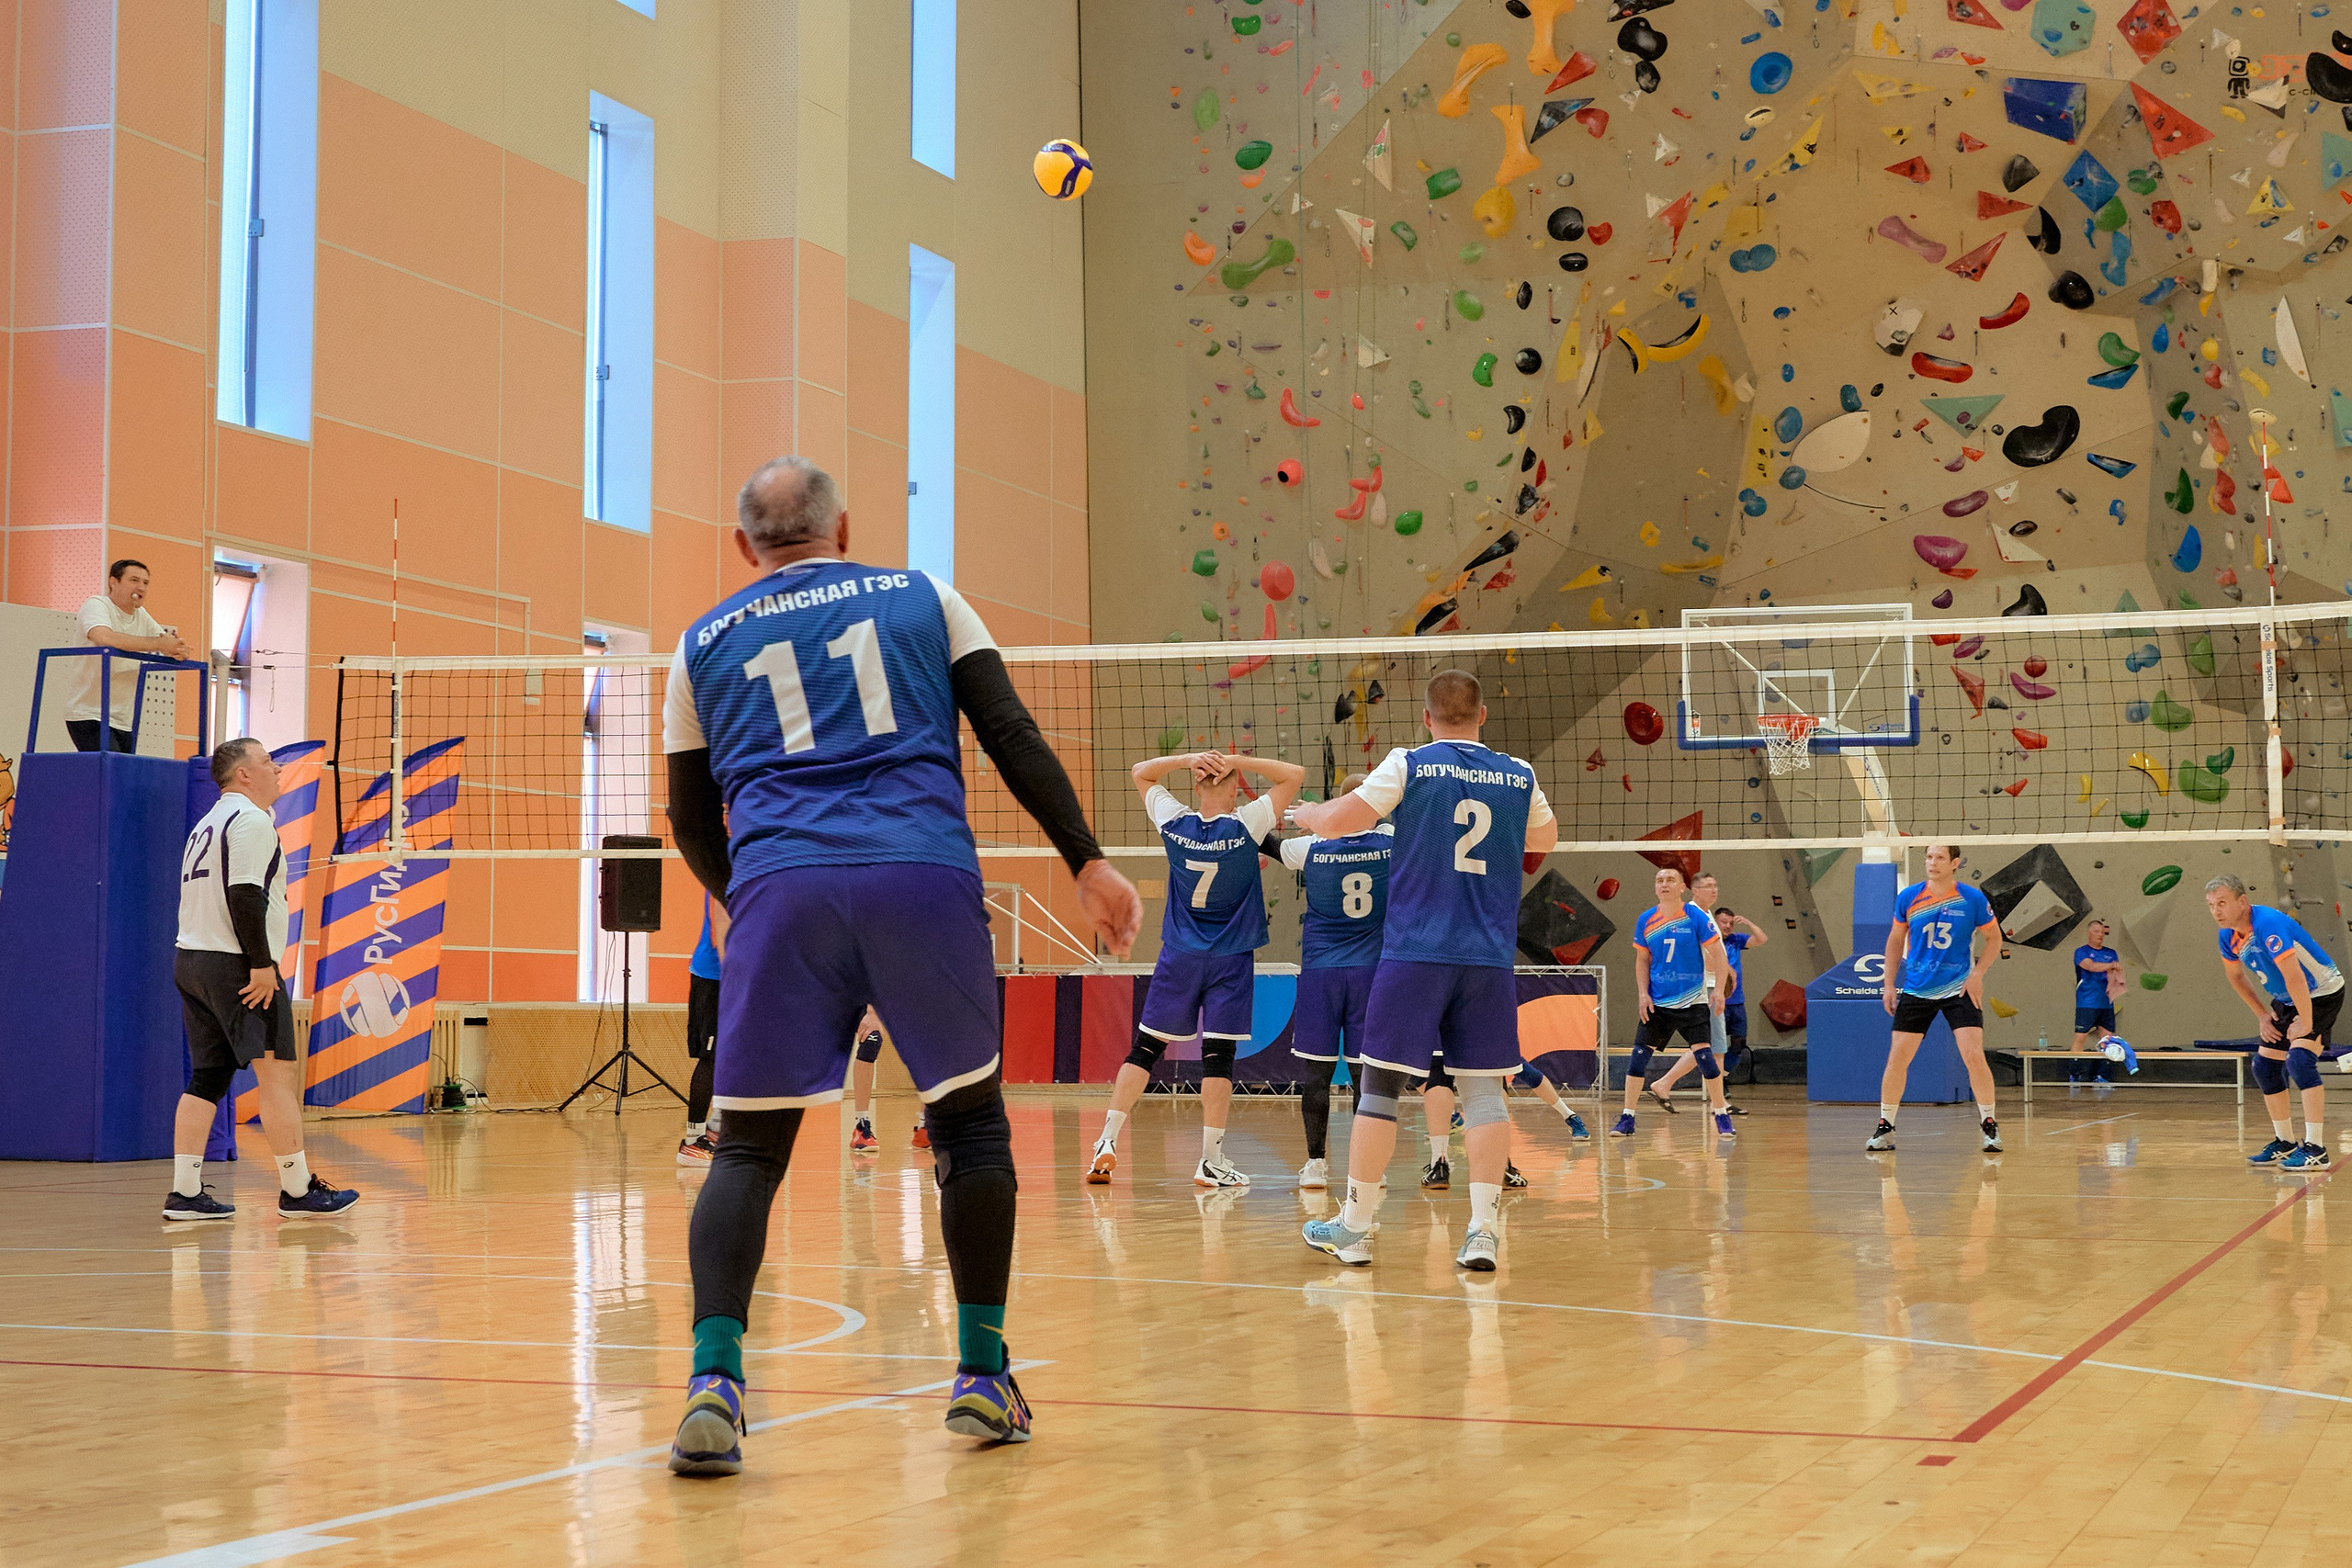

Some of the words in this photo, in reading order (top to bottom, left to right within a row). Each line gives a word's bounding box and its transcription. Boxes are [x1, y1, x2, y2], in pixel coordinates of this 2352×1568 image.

[863, 574, 910, 593] ГЭС
[743, 618, 898, 755] 11
[1416, 763, 1504, 785] БОГУЧАНСКАЯ
[1506, 773, 1528, 789] ГЭС
[1227, 837, 1246, 850] ГЭС
[1453, 799, 1492, 874] 2
[1313, 851, 1381, 863] БОГУЧАНСКАЯ
[1185, 859, 1219, 908] 7
[1341, 872, 1373, 919] 8
[1922, 921, 1952, 950] 13
[1663, 938, 1676, 964] 7
[1835, 987, 1878, 995] Schelde
